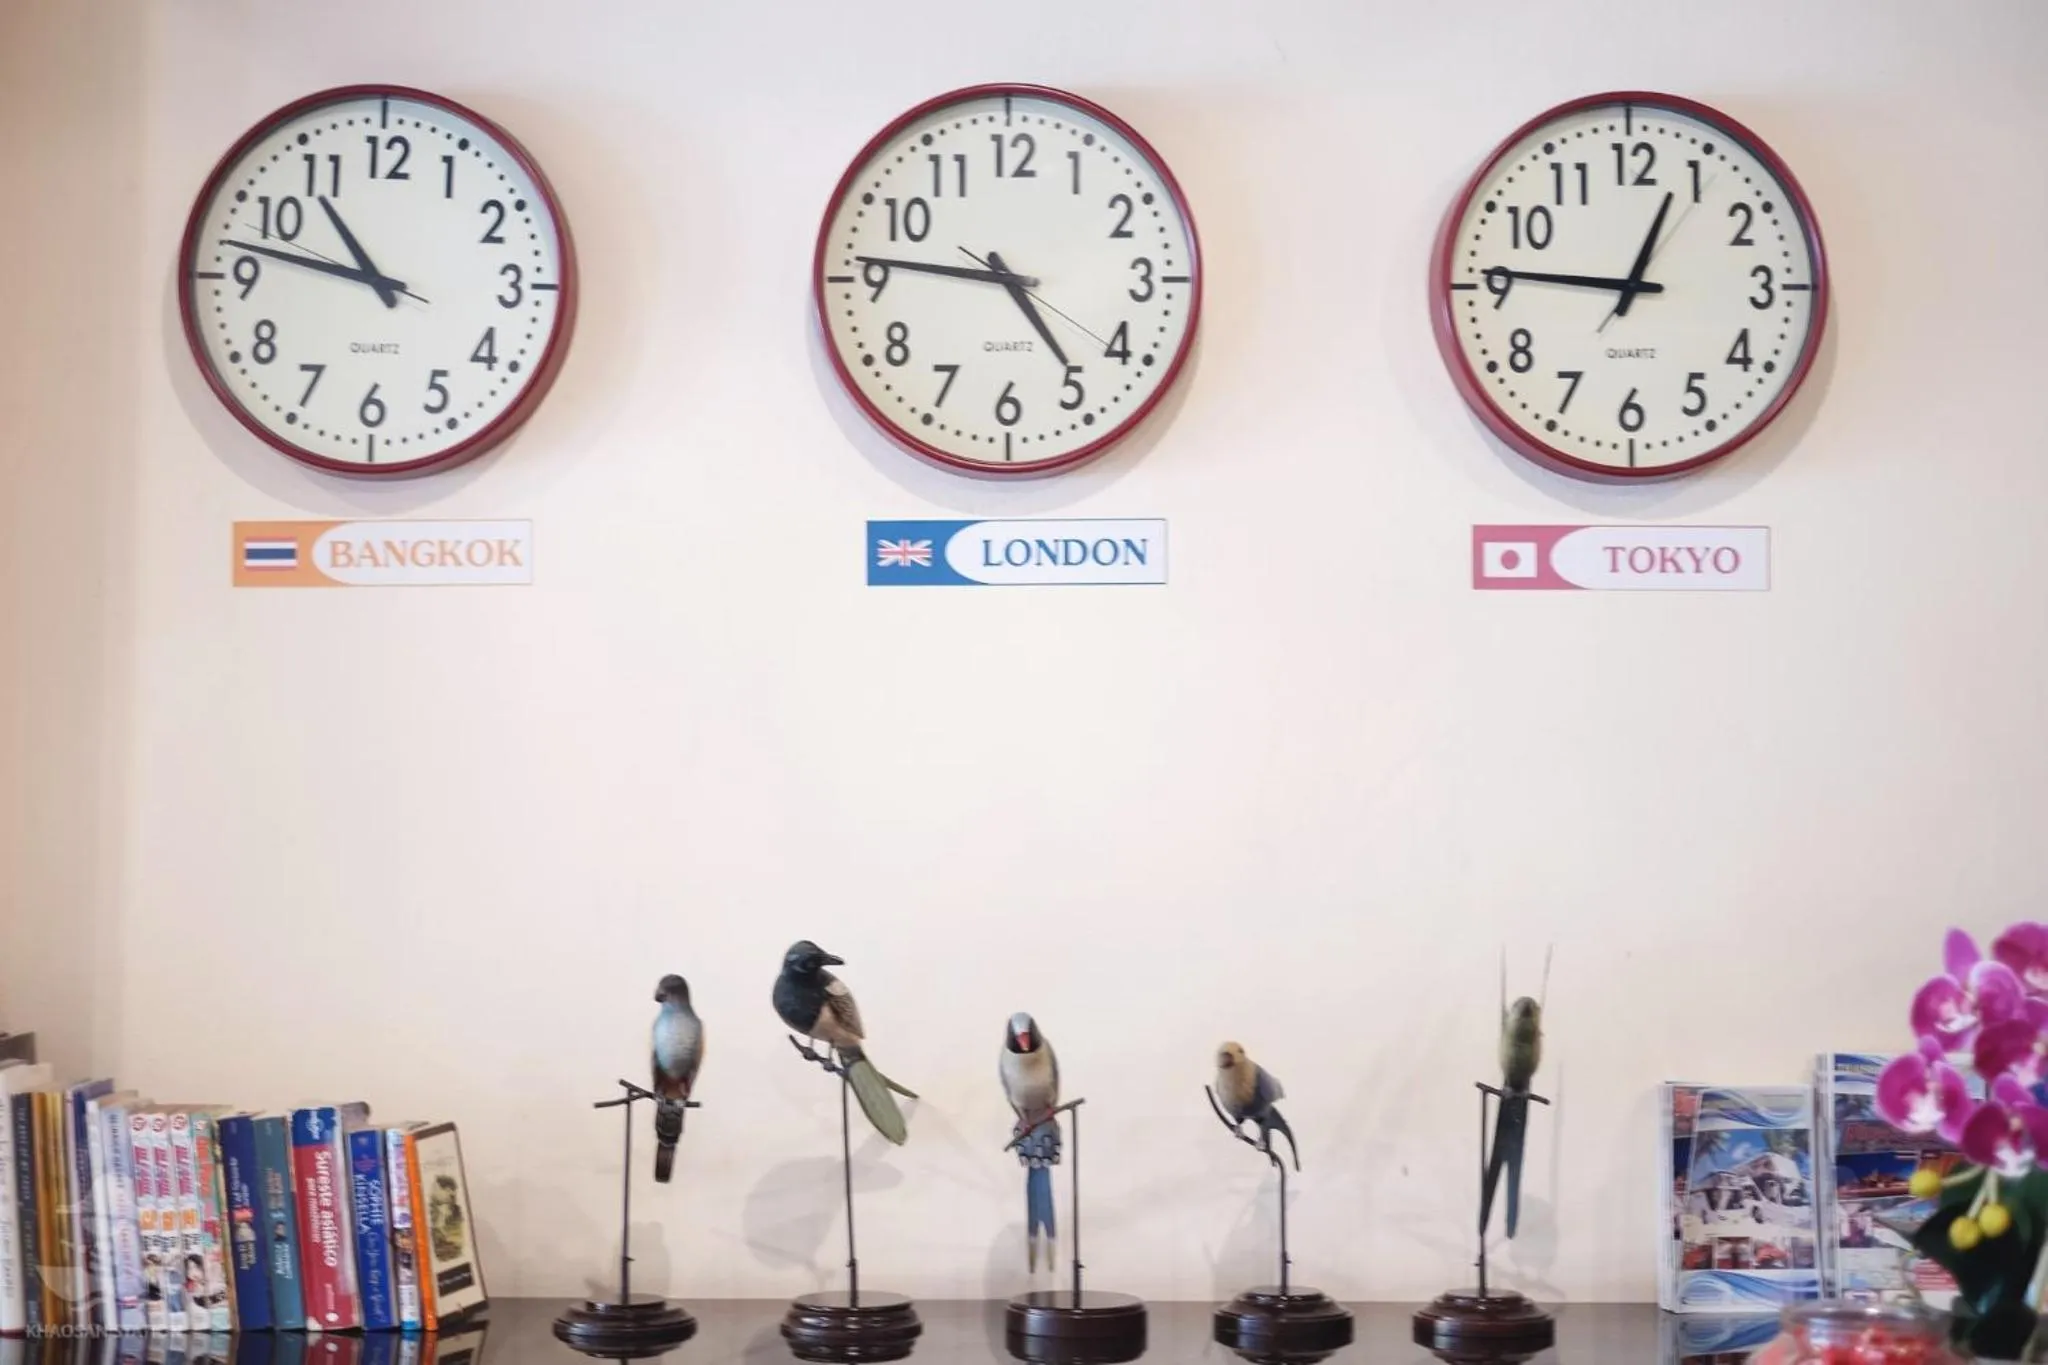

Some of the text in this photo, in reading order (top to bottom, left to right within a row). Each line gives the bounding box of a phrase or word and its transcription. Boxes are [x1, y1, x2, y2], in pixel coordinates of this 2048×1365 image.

[303, 153, 341, 198] 11
[366, 135, 411, 181] 12
[441, 155, 454, 199] 1
[928, 154, 966, 198] 11
[991, 133, 1035, 178] 12
[1068, 151, 1079, 195] 1
[1611, 141, 1657, 187] 12
[1550, 162, 1588, 206] 11
[1686, 159, 1702, 204] 1
[257, 195, 303, 243] 10
[480, 199, 505, 244] 2
[884, 197, 931, 243] 10
[1108, 193, 1133, 239] 2
[1507, 204, 1553, 251] 10
[1728, 201, 1755, 247] 2
[232, 255, 260, 301] 9
[497, 263, 522, 309] 3
[862, 261, 890, 304] 9
[1129, 257, 1154, 303] 3
[1485, 265, 1513, 310] 9
[1749, 264, 1775, 311] 3
[252, 319, 277, 365] 8
[349, 341, 401, 355] QUARTZ
[470, 327, 498, 371] 4
[885, 321, 910, 367] 8
[982, 340, 1034, 354] QUARTZ
[1103, 320, 1132, 366] 4
[1508, 327, 1534, 374] 8
[1605, 346, 1657, 361] QUARTZ
[1725, 327, 1754, 373] 4
[299, 363, 326, 407] 7
[359, 383, 386, 428] 6
[423, 369, 449, 414] 5
[933, 364, 960, 408] 7
[995, 381, 1022, 427] 6
[1059, 365, 1085, 412] 5
[1557, 370, 1584, 415] 7
[1681, 372, 1707, 417] 5
[1618, 387, 1645, 433] 6
[328, 539, 524, 568] BANGKOK
[982, 538, 1148, 567] LONDON
[1603, 546, 1741, 574] TOKYO
[314, 1151, 331, 1207] Sureste
[369, 1179, 384, 1225] SOPHIE
